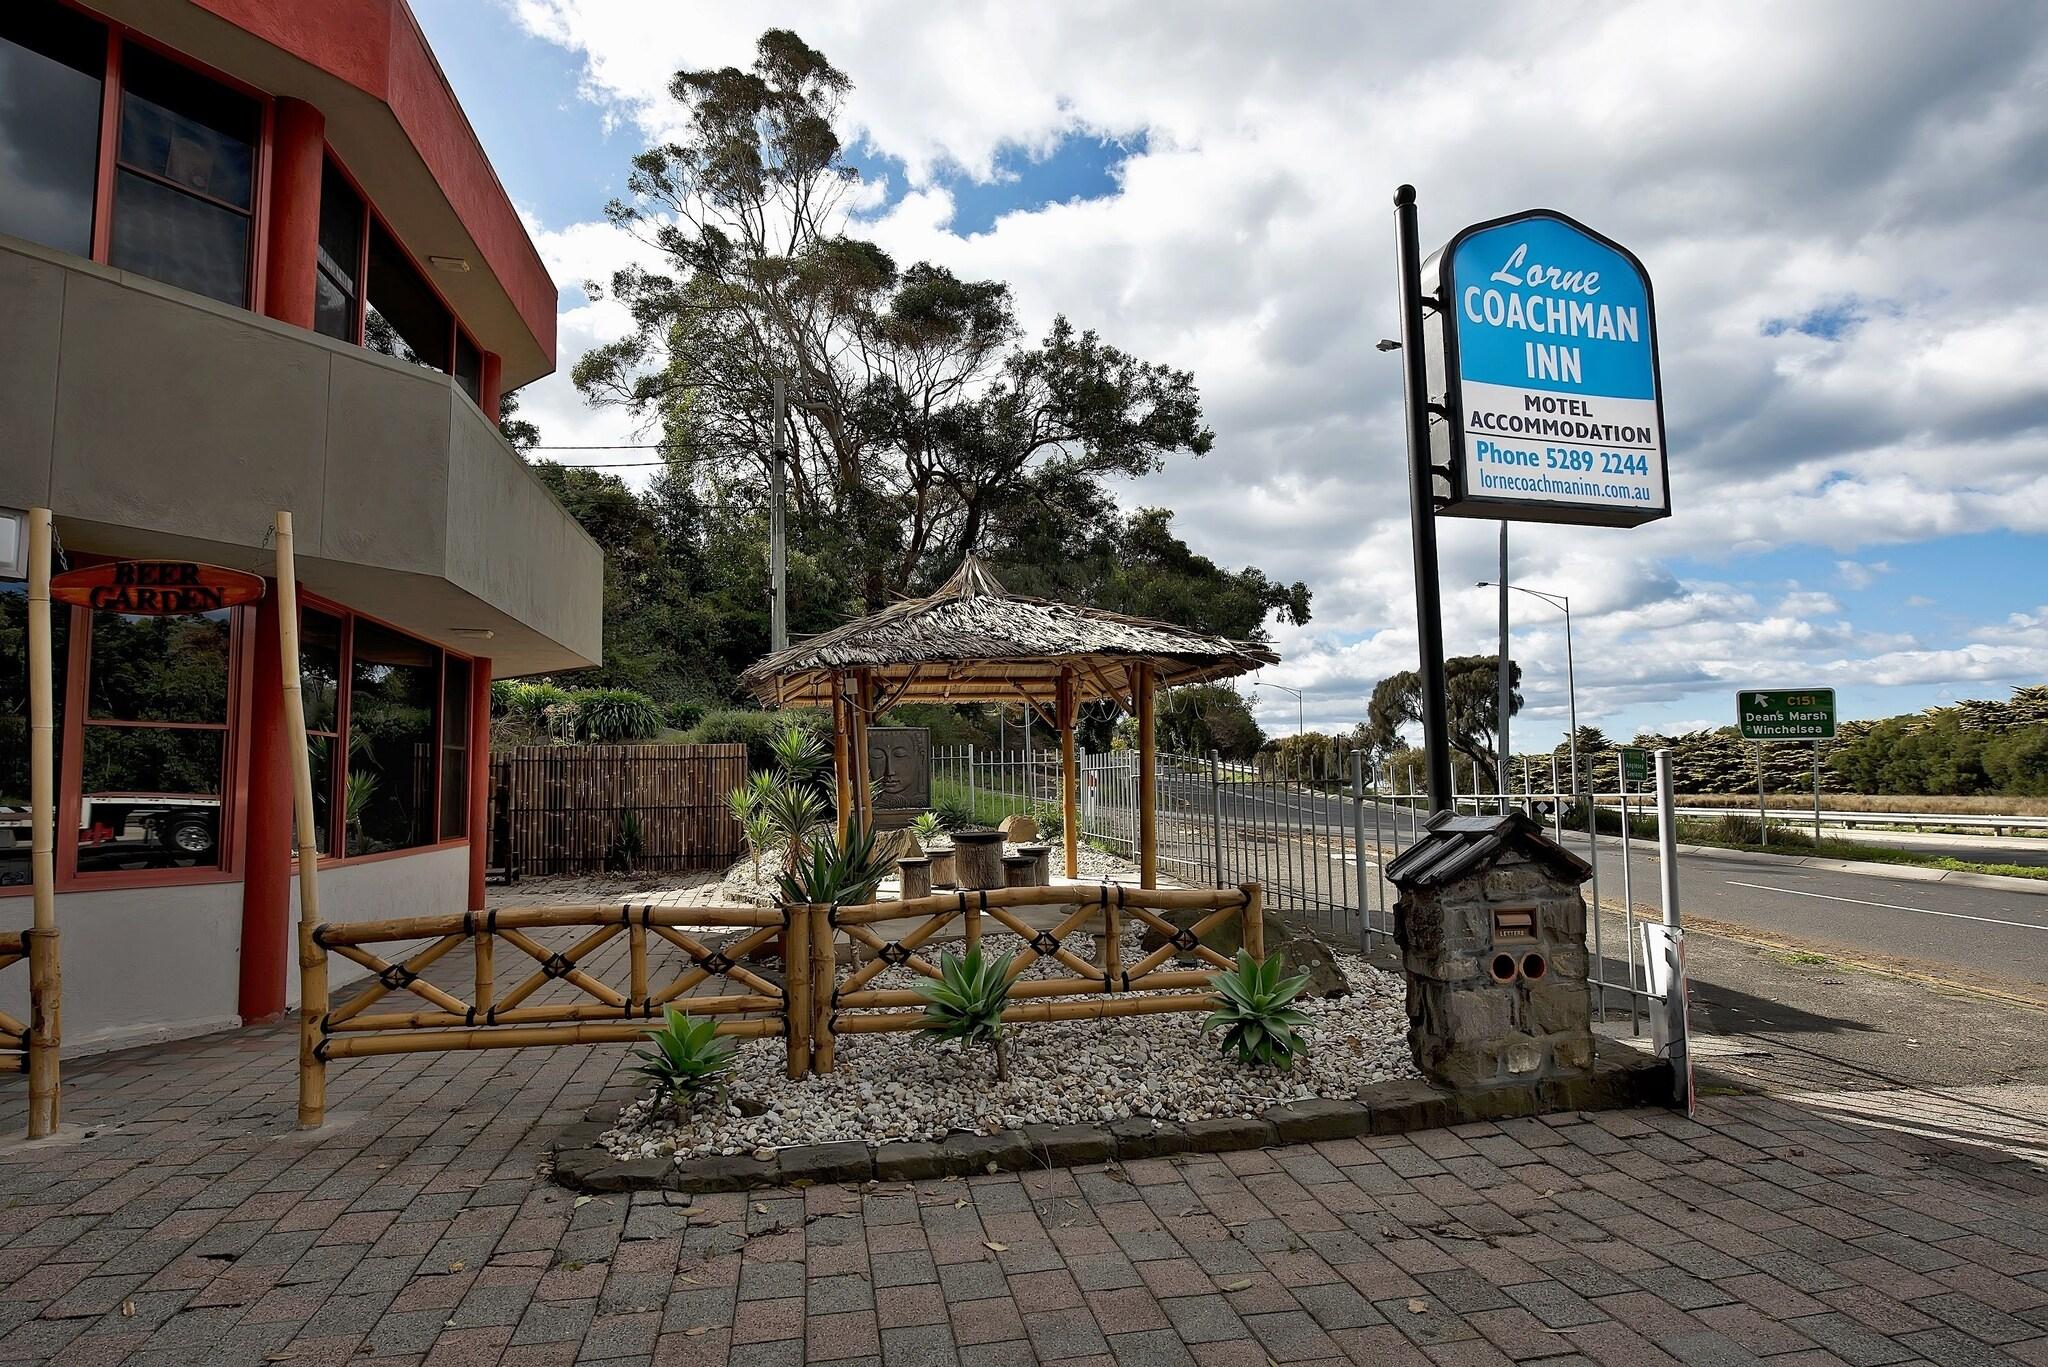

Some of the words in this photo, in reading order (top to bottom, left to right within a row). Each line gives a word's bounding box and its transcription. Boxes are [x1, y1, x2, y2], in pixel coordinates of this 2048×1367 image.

[1490, 243, 1600, 295] Lorne
[1464, 286, 1639, 342] COACHMAN
[1525, 342, 1582, 384] INN
[1524, 395, 1593, 417] MOTEL
[1470, 411, 1652, 444] ACCOMMODATION
[1476, 440, 1540, 468] Phone
[1546, 447, 1593, 472] 5289
[1601, 452, 1648, 476] 2244
[1480, 469, 1651, 501] lornecoachmaninn.com.au
[115, 562, 200, 585] BEER
[90, 586, 225, 611] GARDEN
[1787, 696, 1816, 706] C151
[1746, 710, 1785, 722] Dean's
[1789, 711, 1828, 721] Marsh
[1753, 725, 1823, 735] Winchelsea
